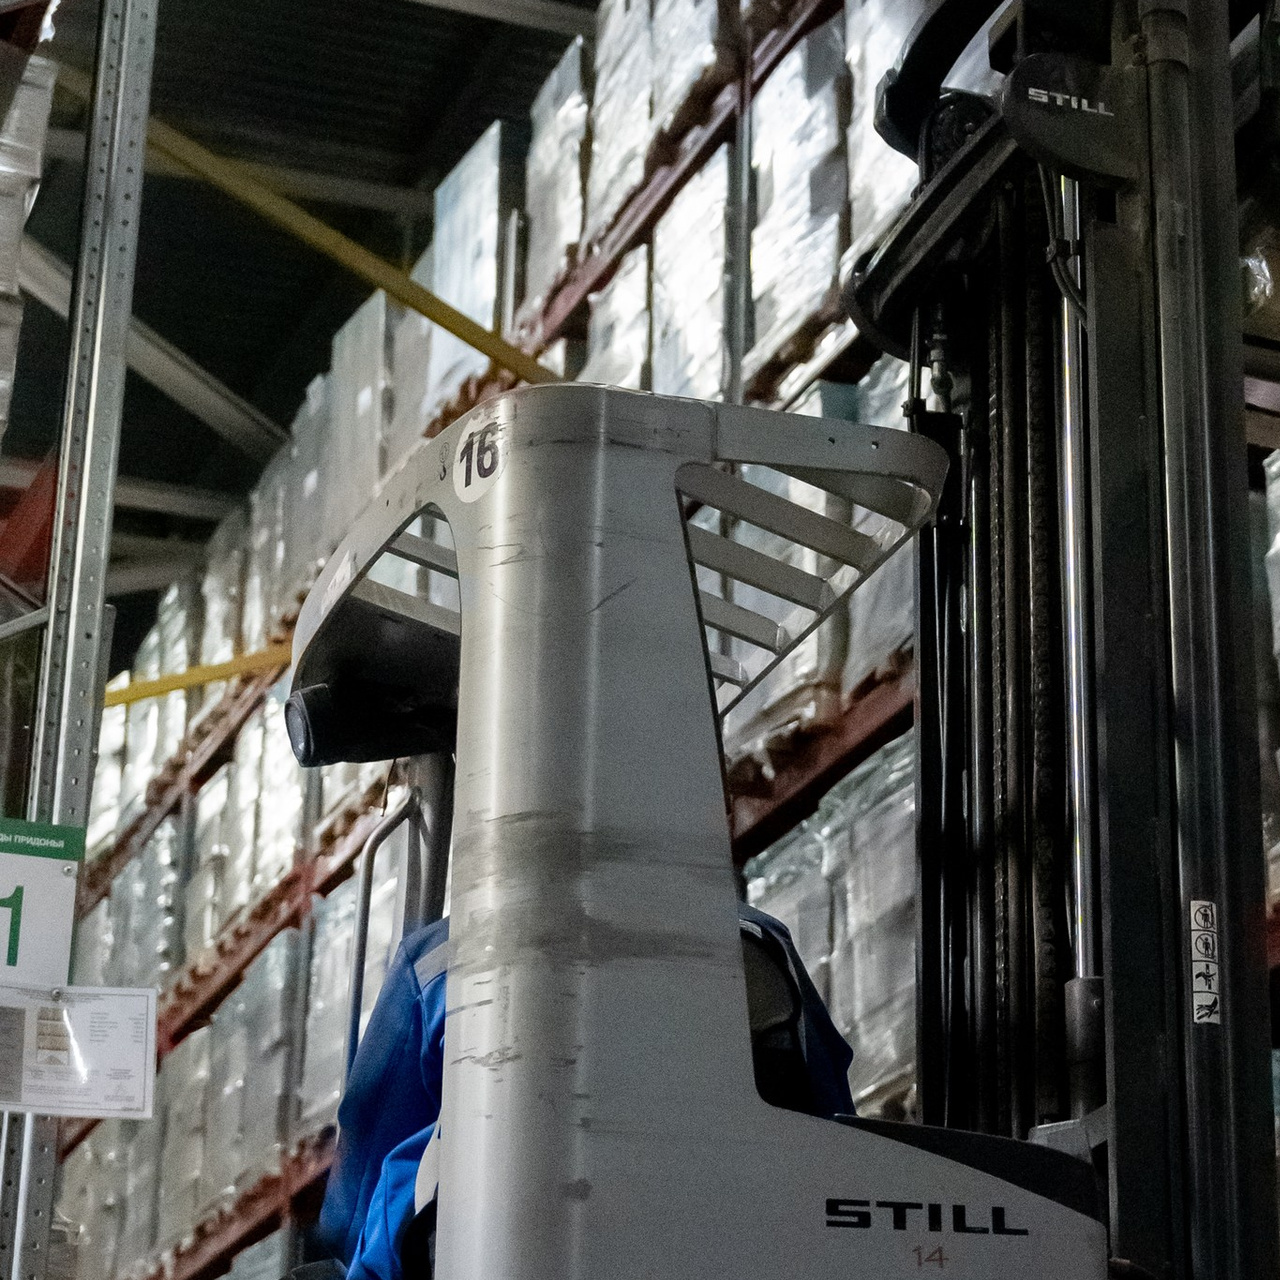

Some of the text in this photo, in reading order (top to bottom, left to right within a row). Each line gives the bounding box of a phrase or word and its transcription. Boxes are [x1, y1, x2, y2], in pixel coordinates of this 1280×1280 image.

[1028, 87, 1114, 117] STILL
[459, 421, 500, 489] 16
[14, 834, 65, 849] ПРИДОНЬЯ
[826, 1198, 1029, 1236] STILL
[911, 1245, 949, 1269] 14
